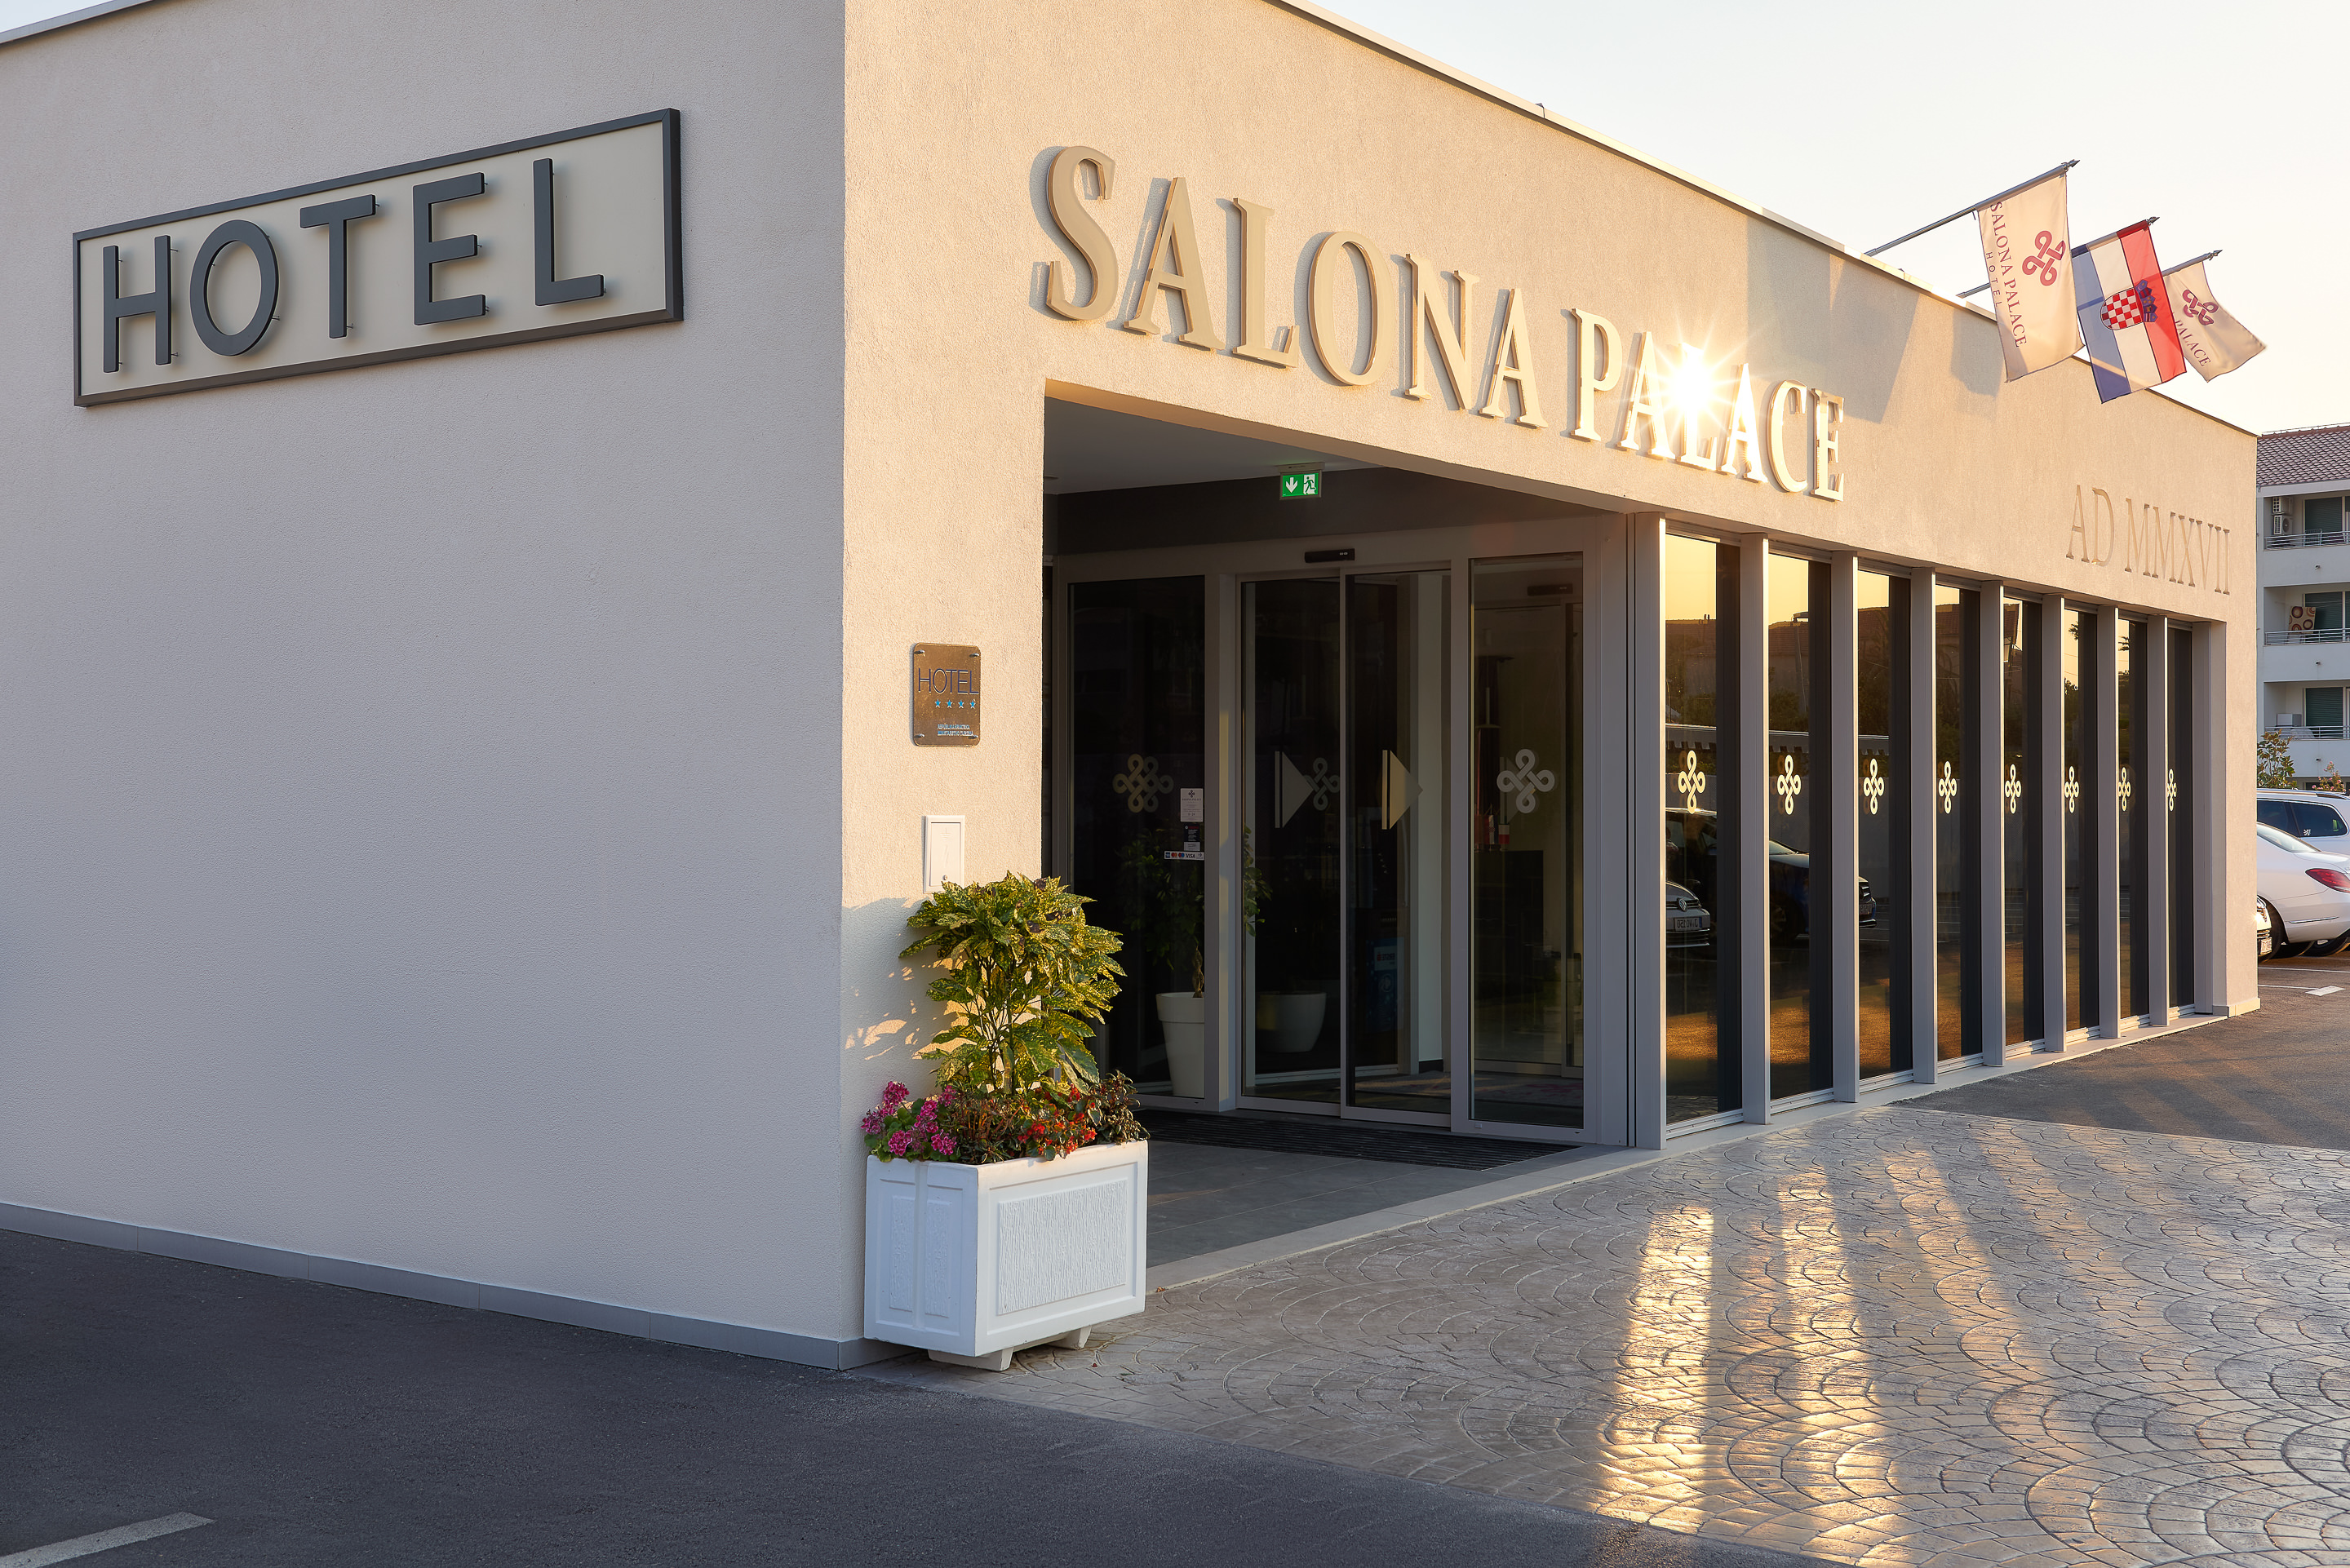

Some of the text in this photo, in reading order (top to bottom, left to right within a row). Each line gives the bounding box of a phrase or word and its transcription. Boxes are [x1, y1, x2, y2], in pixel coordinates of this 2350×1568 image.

[103, 158, 605, 373] HOTEL
[1044, 145, 1844, 502] SALONA PALACE
[1985, 251, 2002, 308] HOTEL
[1990, 202, 2027, 348] SALONA PALACE
[2065, 485, 2230, 596] AD MMXVII
[918, 668, 980, 695] HOTEL
